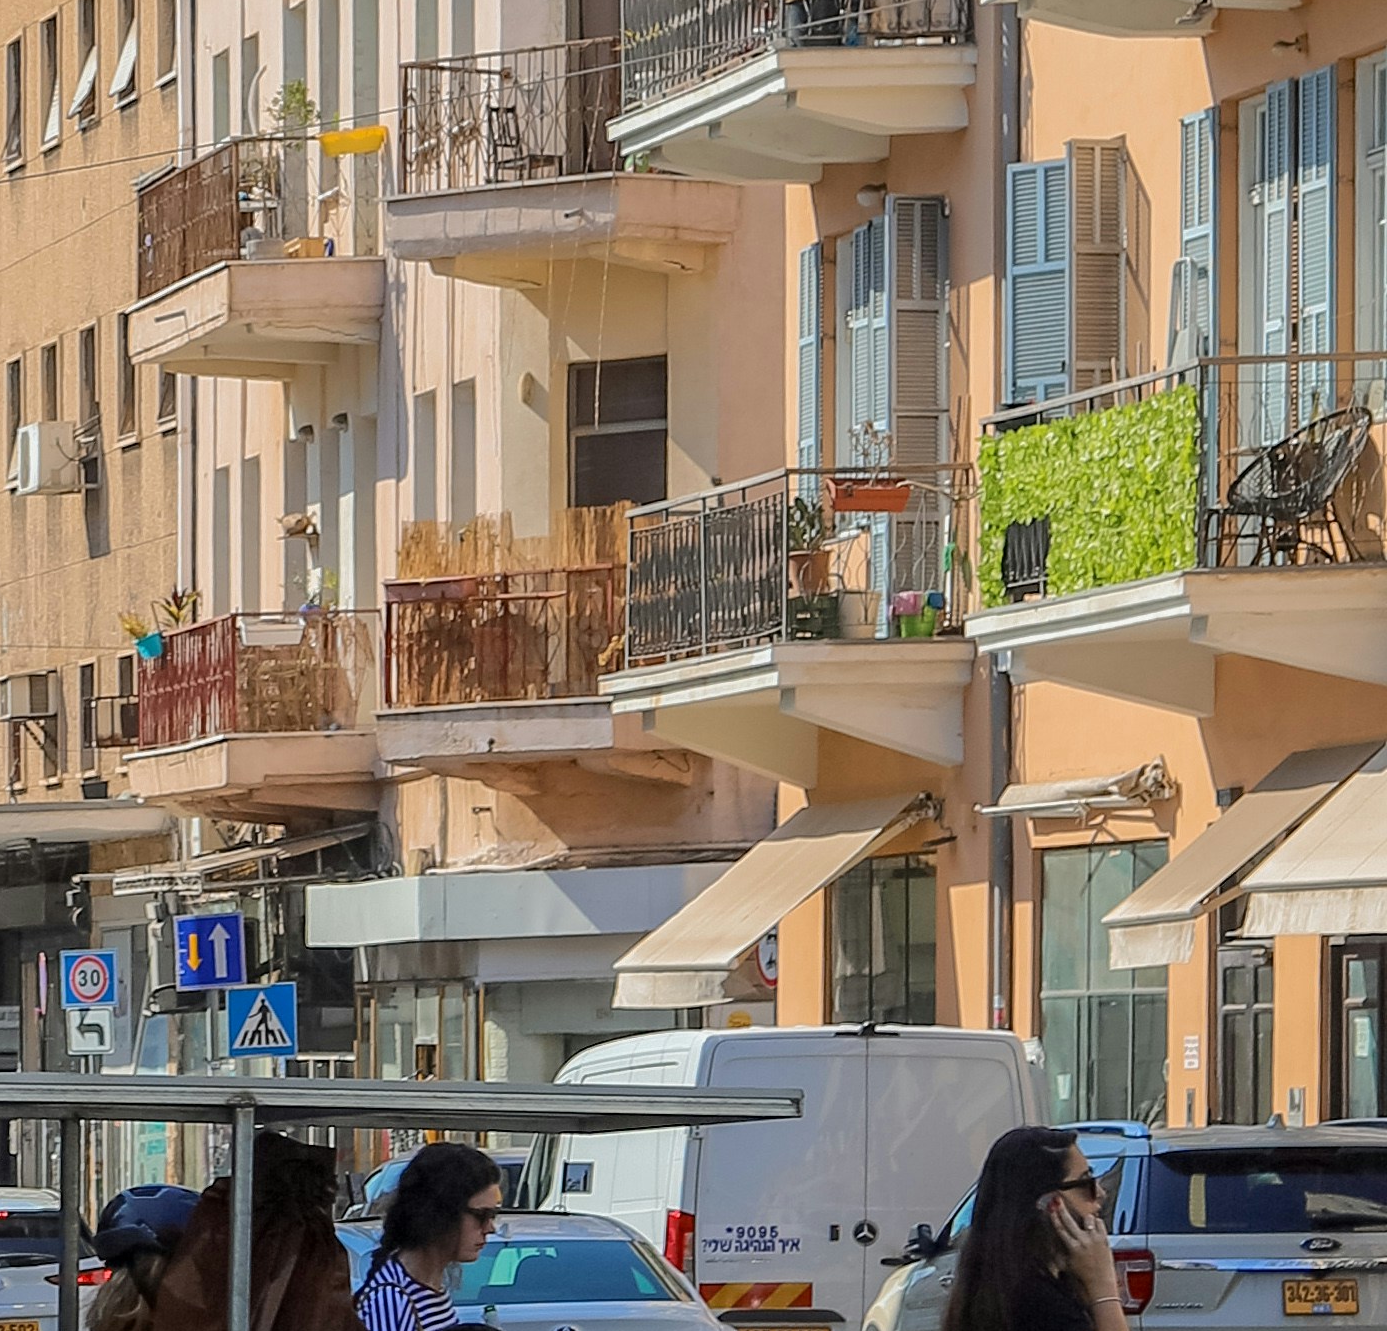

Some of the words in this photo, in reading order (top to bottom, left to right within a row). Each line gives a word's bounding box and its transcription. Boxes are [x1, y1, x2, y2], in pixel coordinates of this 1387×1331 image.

[78, 969, 101, 987] 30
[702, 1239, 732, 1253] שלי?
[734, 1239, 776, 1252] הנהיגה
[778, 1238, 801, 1253] איך
